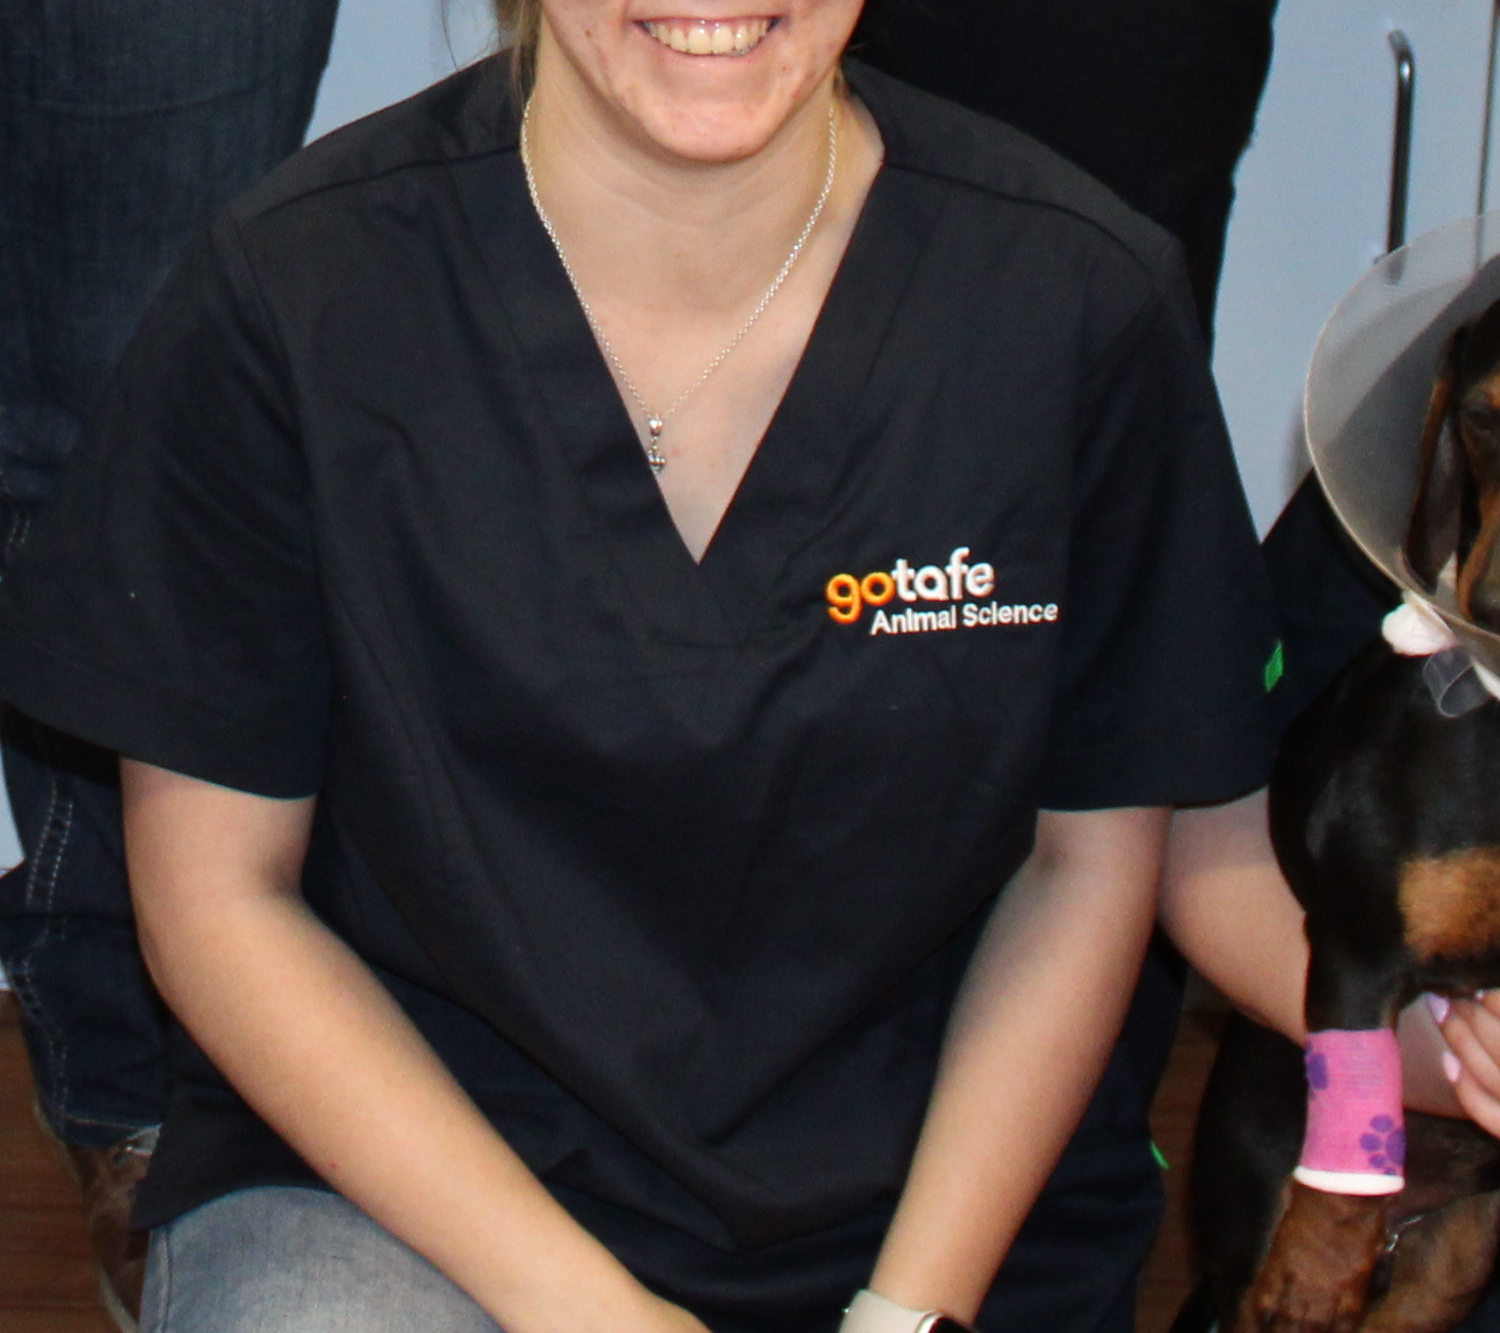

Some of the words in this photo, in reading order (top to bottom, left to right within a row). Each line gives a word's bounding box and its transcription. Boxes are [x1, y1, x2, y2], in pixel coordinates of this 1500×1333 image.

[826, 546, 996, 624] gotafe
[870, 604, 957, 636] Animal
[962, 600, 1059, 627] Science
